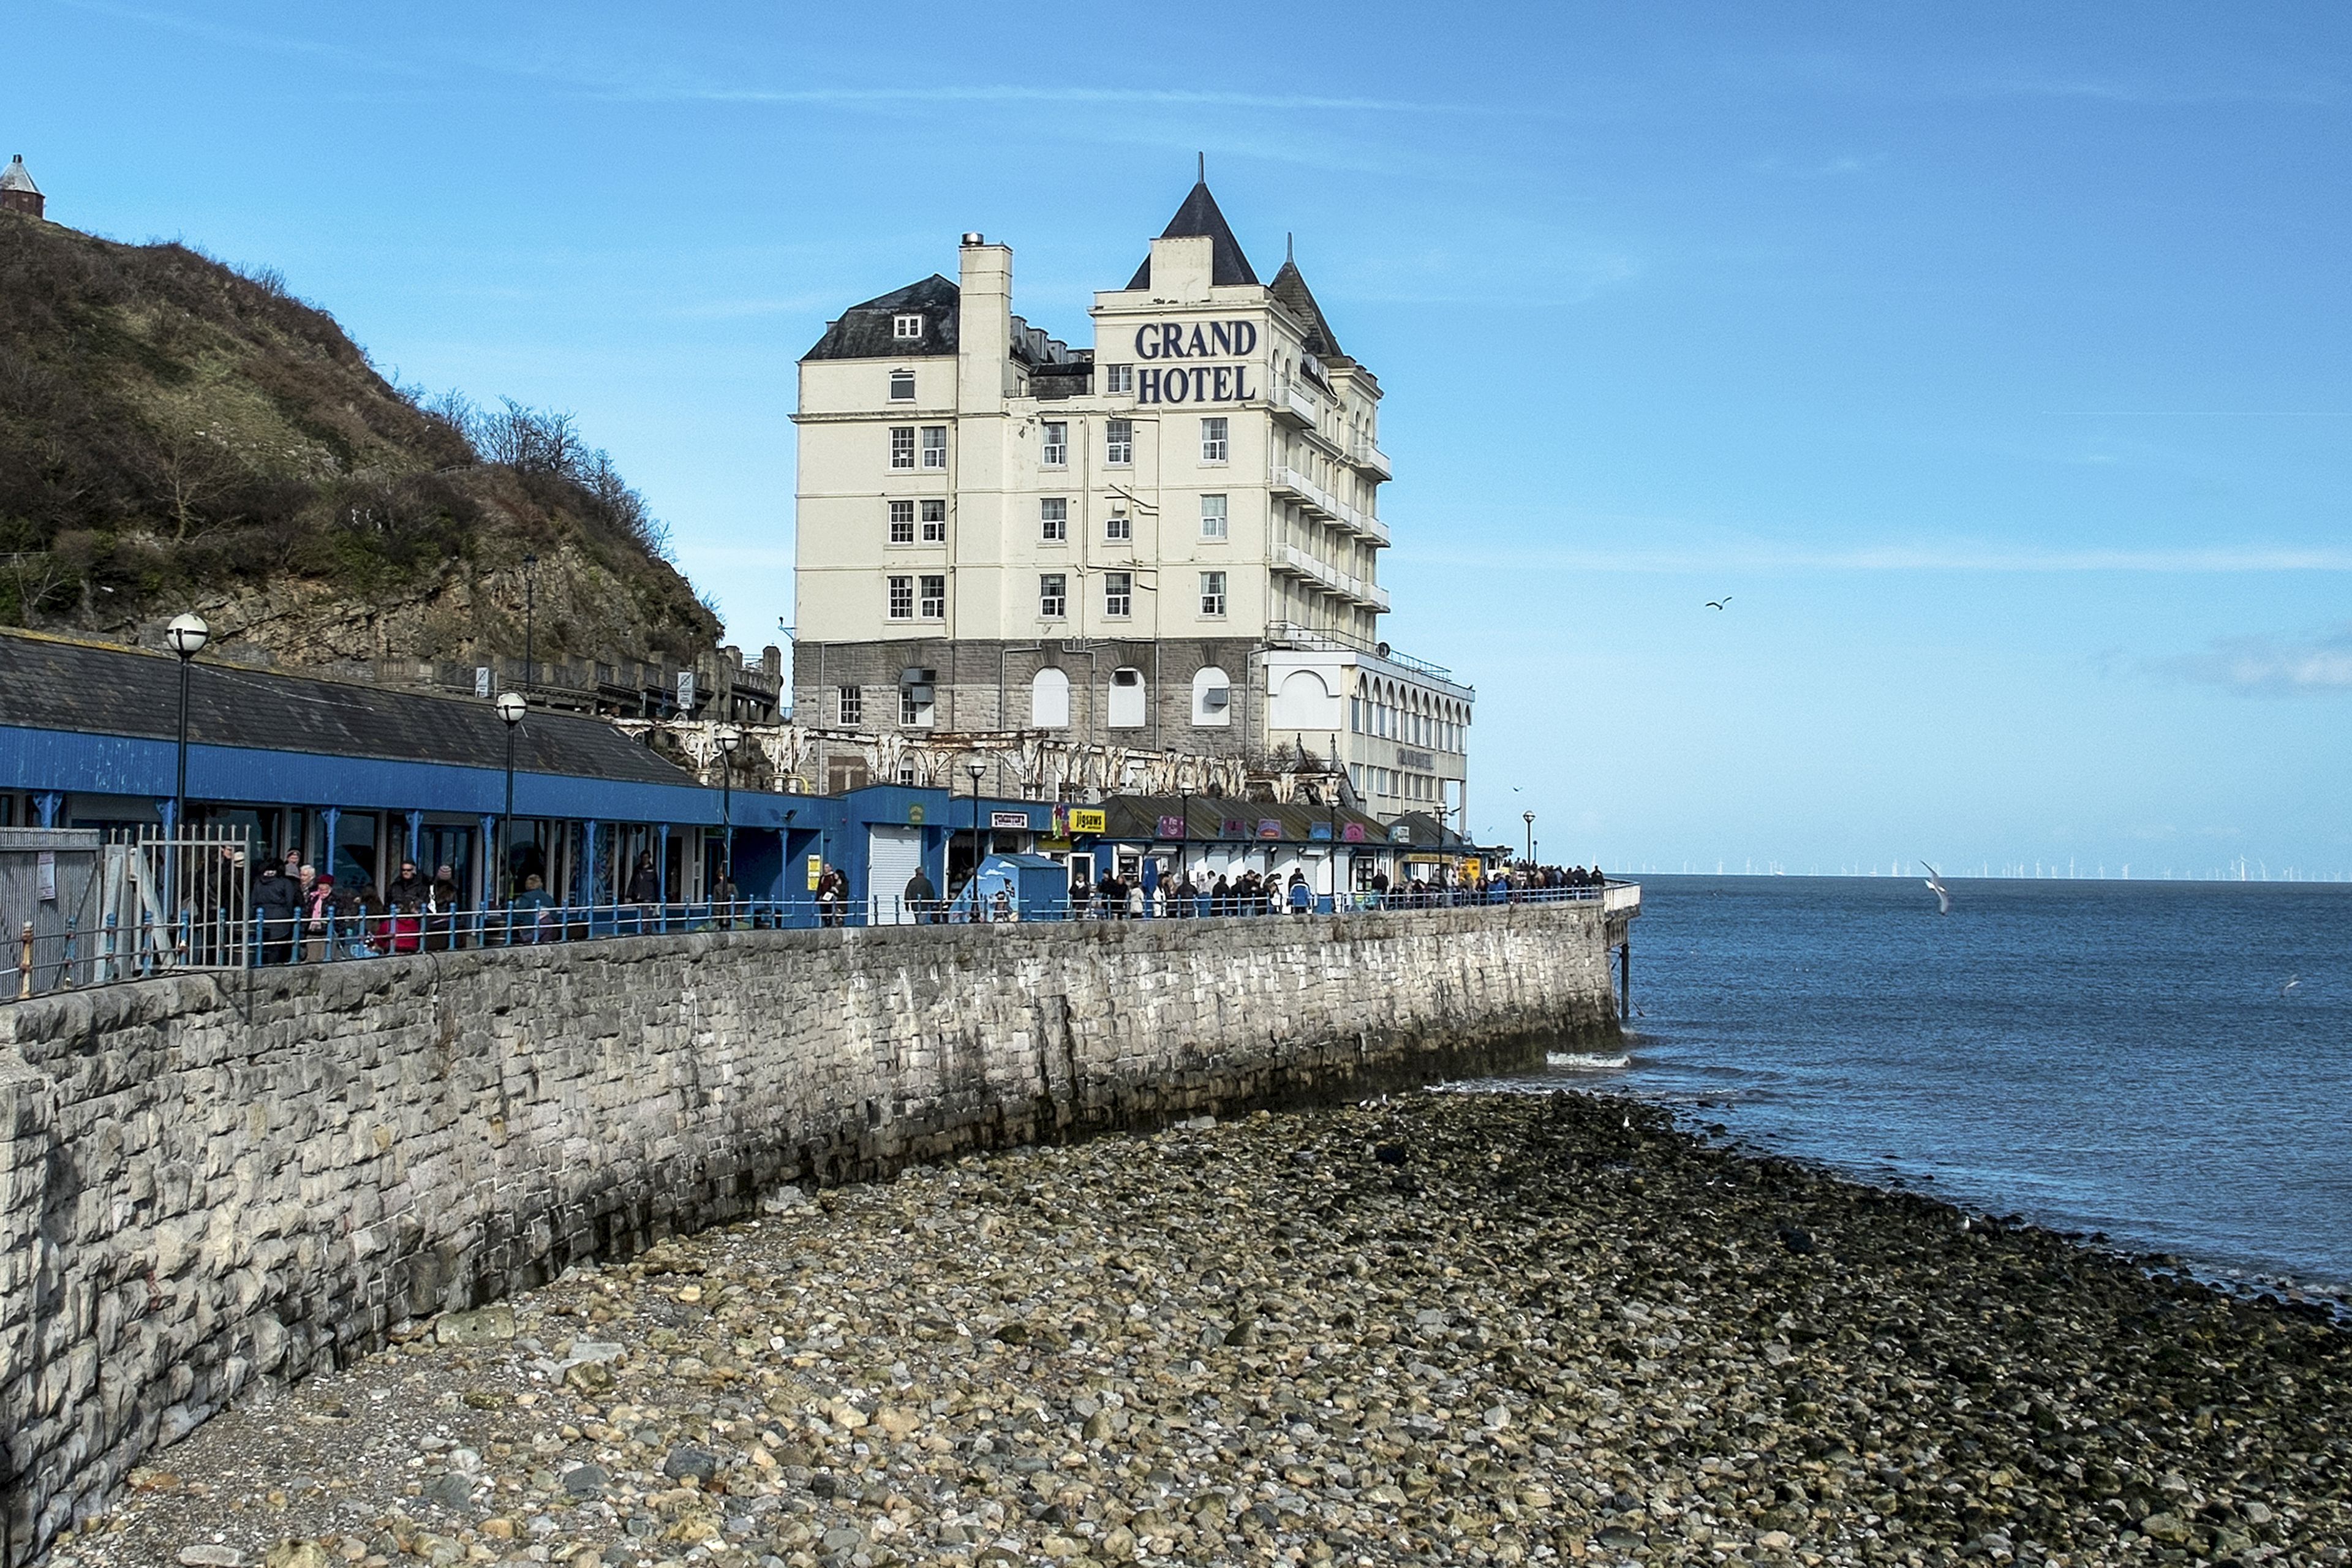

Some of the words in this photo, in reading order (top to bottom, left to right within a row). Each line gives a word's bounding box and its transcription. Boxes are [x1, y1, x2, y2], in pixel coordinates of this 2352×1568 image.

[1136, 321, 1256, 360] GRAND
[1137, 366, 1256, 404] HOTEL
[1076, 811, 1101, 828] jigsaws
